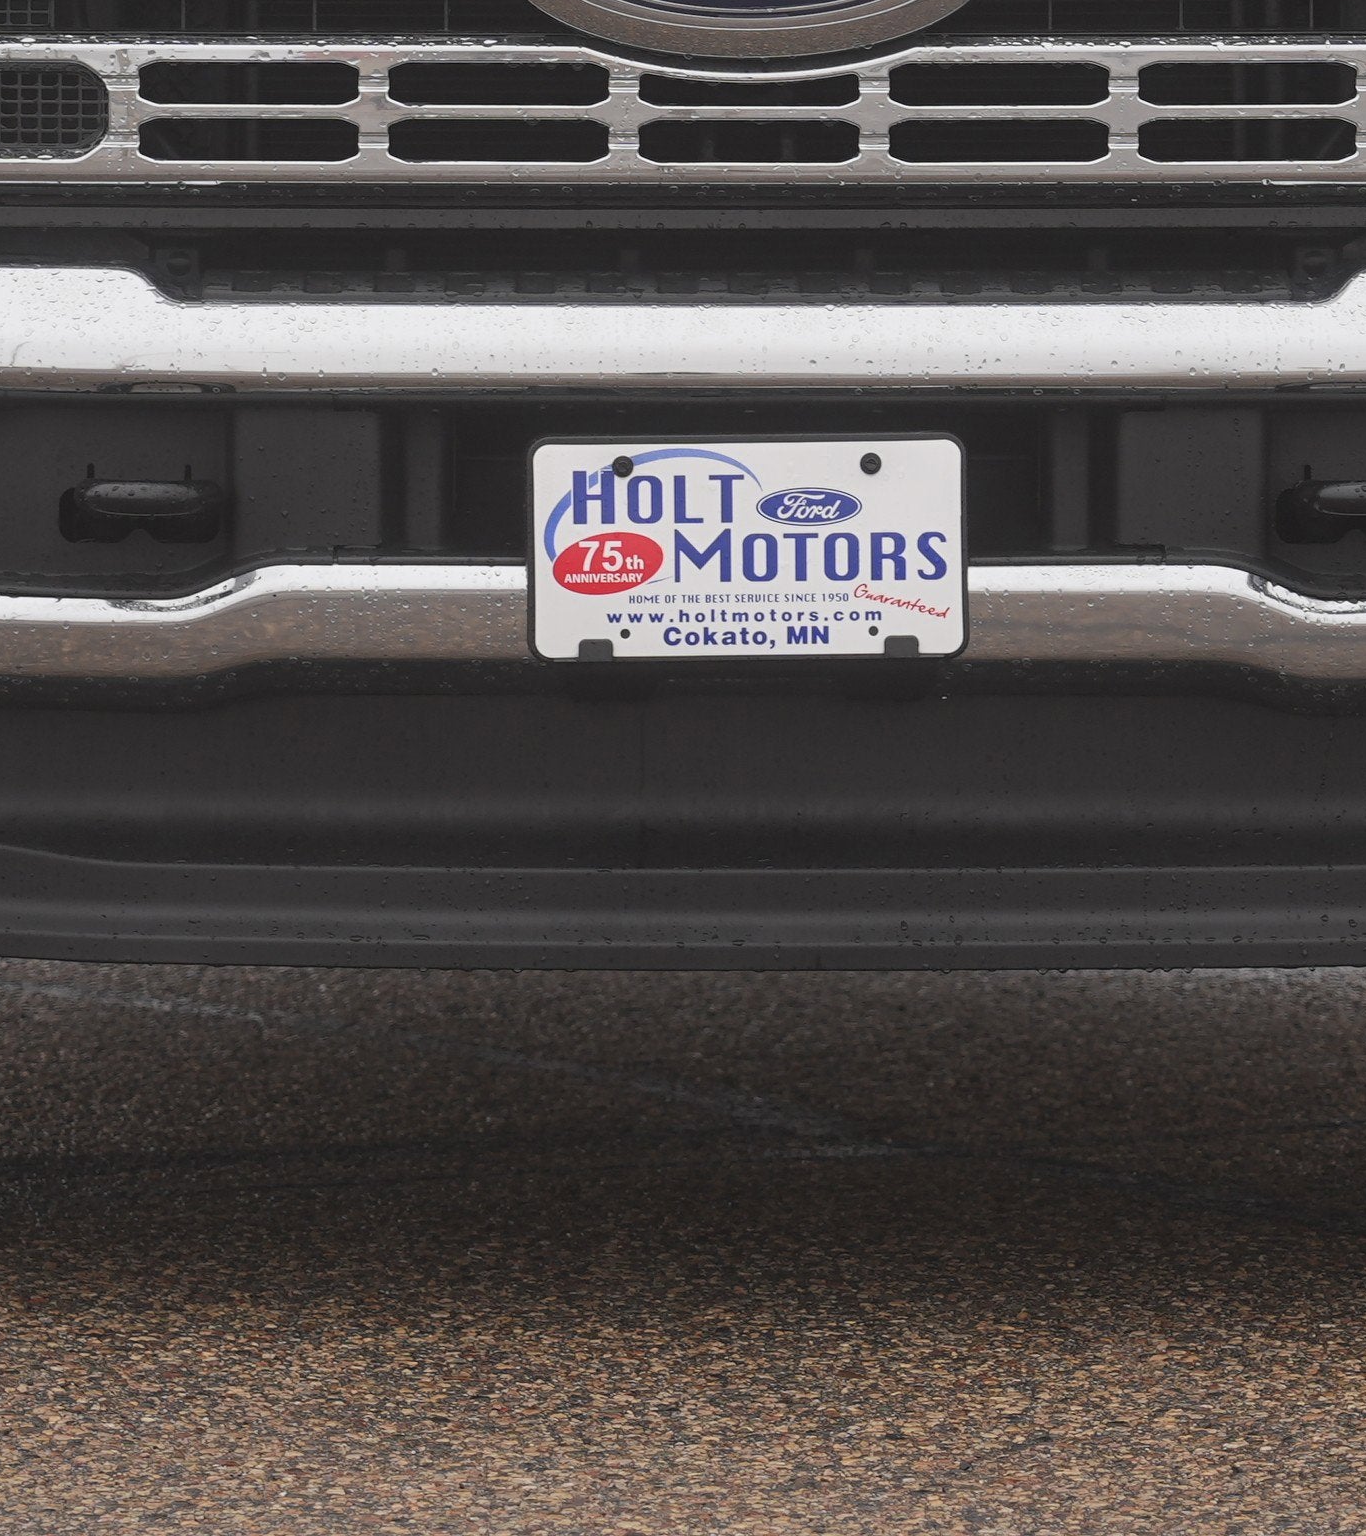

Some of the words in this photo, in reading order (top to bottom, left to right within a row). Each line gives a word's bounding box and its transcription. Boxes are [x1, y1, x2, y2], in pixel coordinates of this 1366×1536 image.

[572, 469, 744, 525] HOLT
[776, 492, 840, 520] Ford
[578, 541, 644, 571] 75th
[674, 529, 948, 582] MOTORS
[564, 573, 644, 584] ANNIVERSARY
[629, 595, 661, 604] HOME
[664, 594, 678, 604] OF
[681, 594, 701, 603] THE
[704, 594, 731, 603] BEST
[734, 593, 781, 603] SERVICE
[784, 593, 818, 603] SINCE
[822, 592, 849, 602] 1950
[854, 583, 951, 619] Guaranteed
[607, 609, 882, 623] www.holtmotors.com
[663, 627, 776, 648] Cokato,
[787, 626, 830, 644] MN
